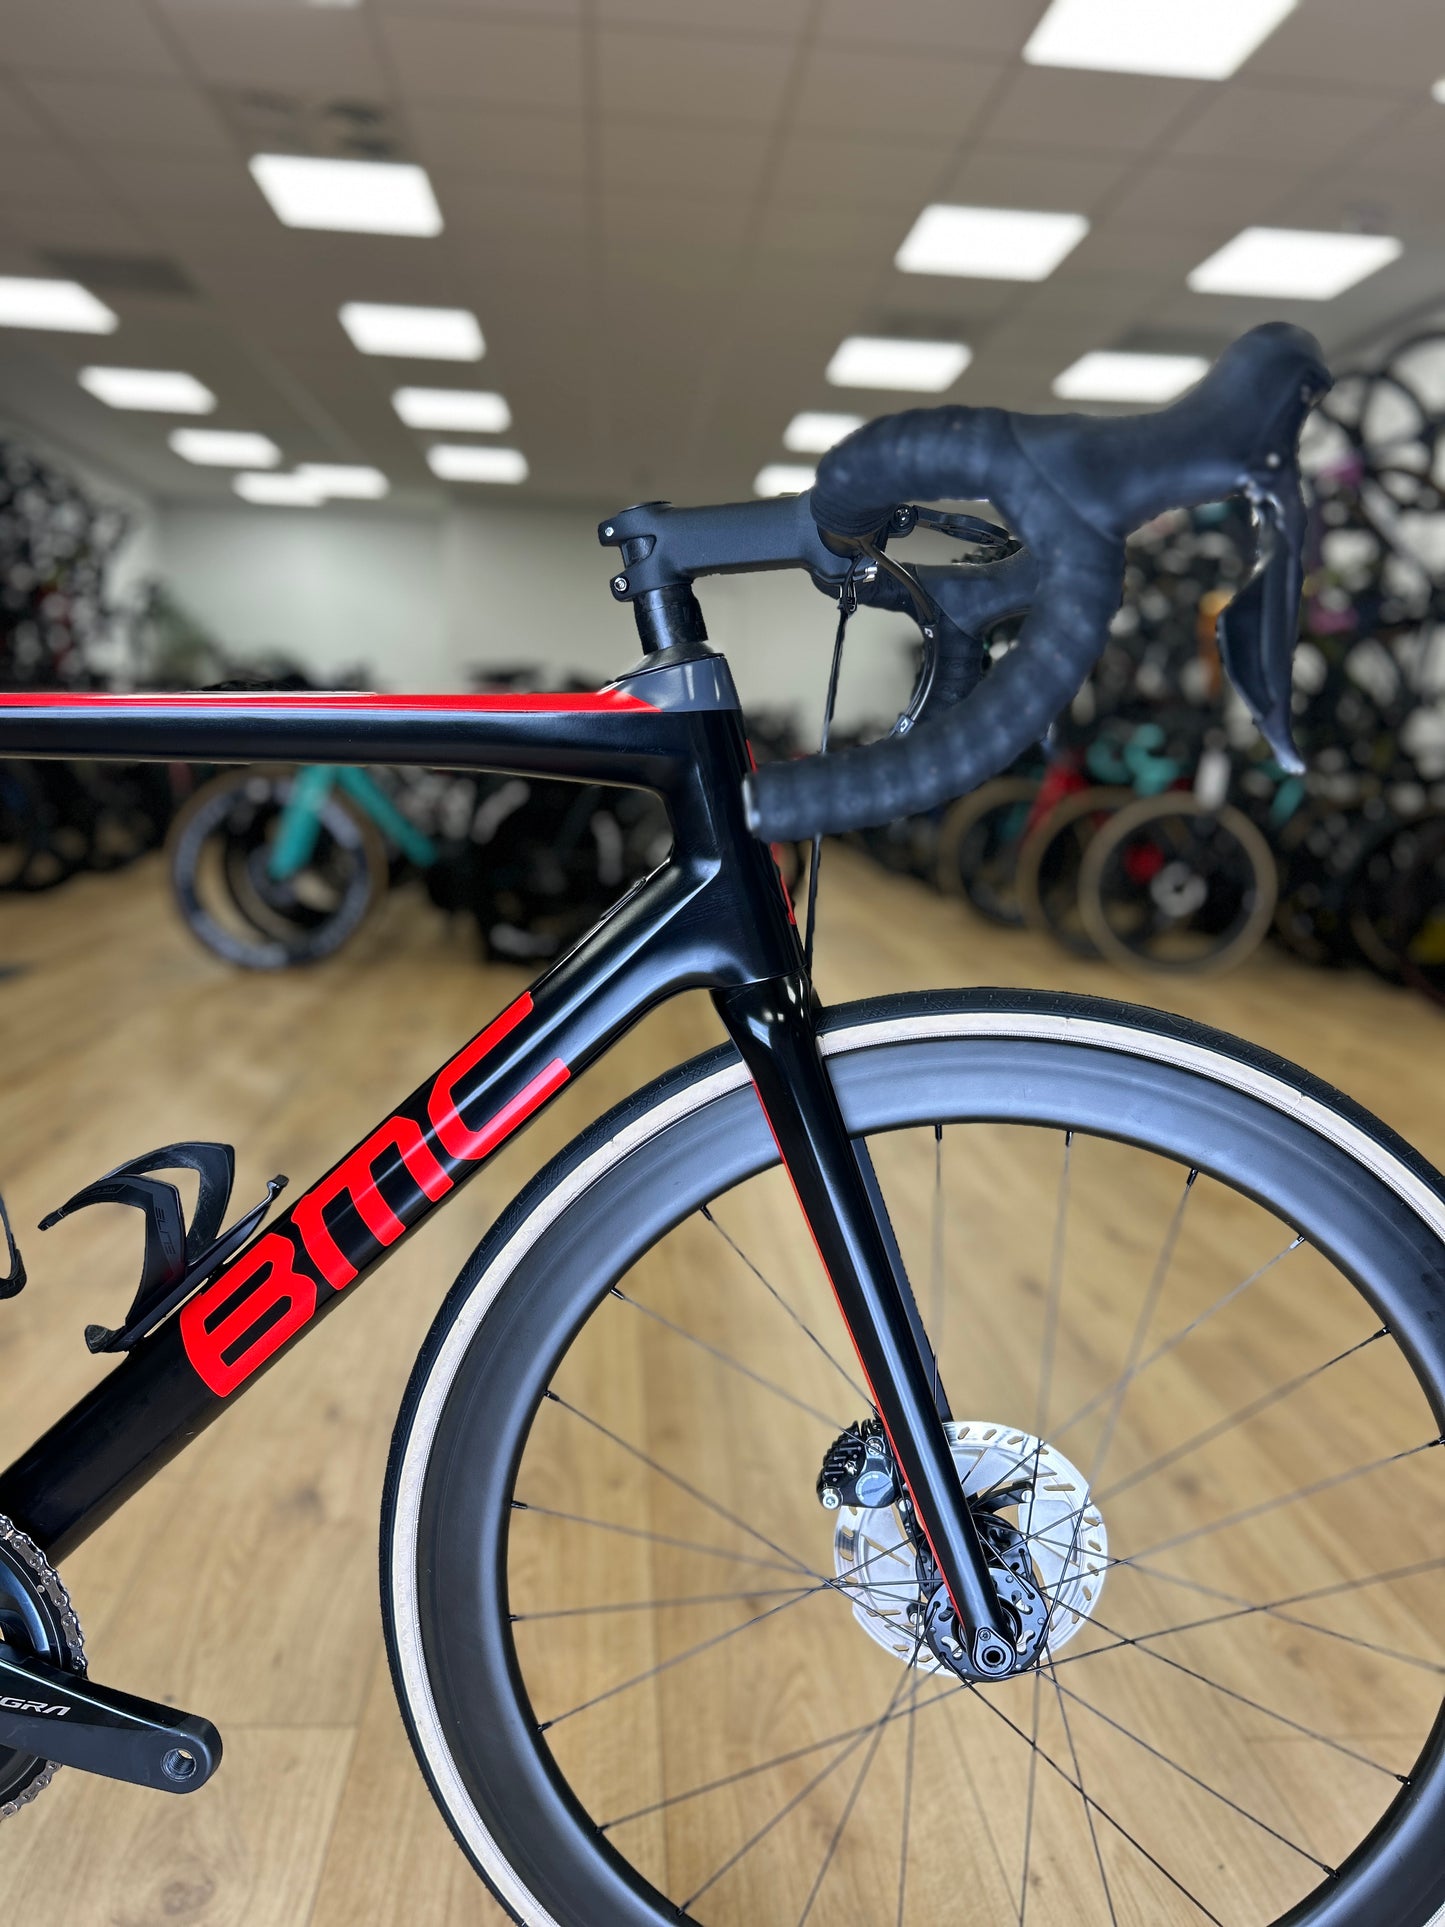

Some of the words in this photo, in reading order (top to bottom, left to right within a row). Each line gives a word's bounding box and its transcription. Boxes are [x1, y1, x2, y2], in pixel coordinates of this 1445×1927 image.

[180, 991, 571, 1397] BMC
[154, 1206, 177, 1255] ELITE
[0, 1695, 71, 1716] GRA
